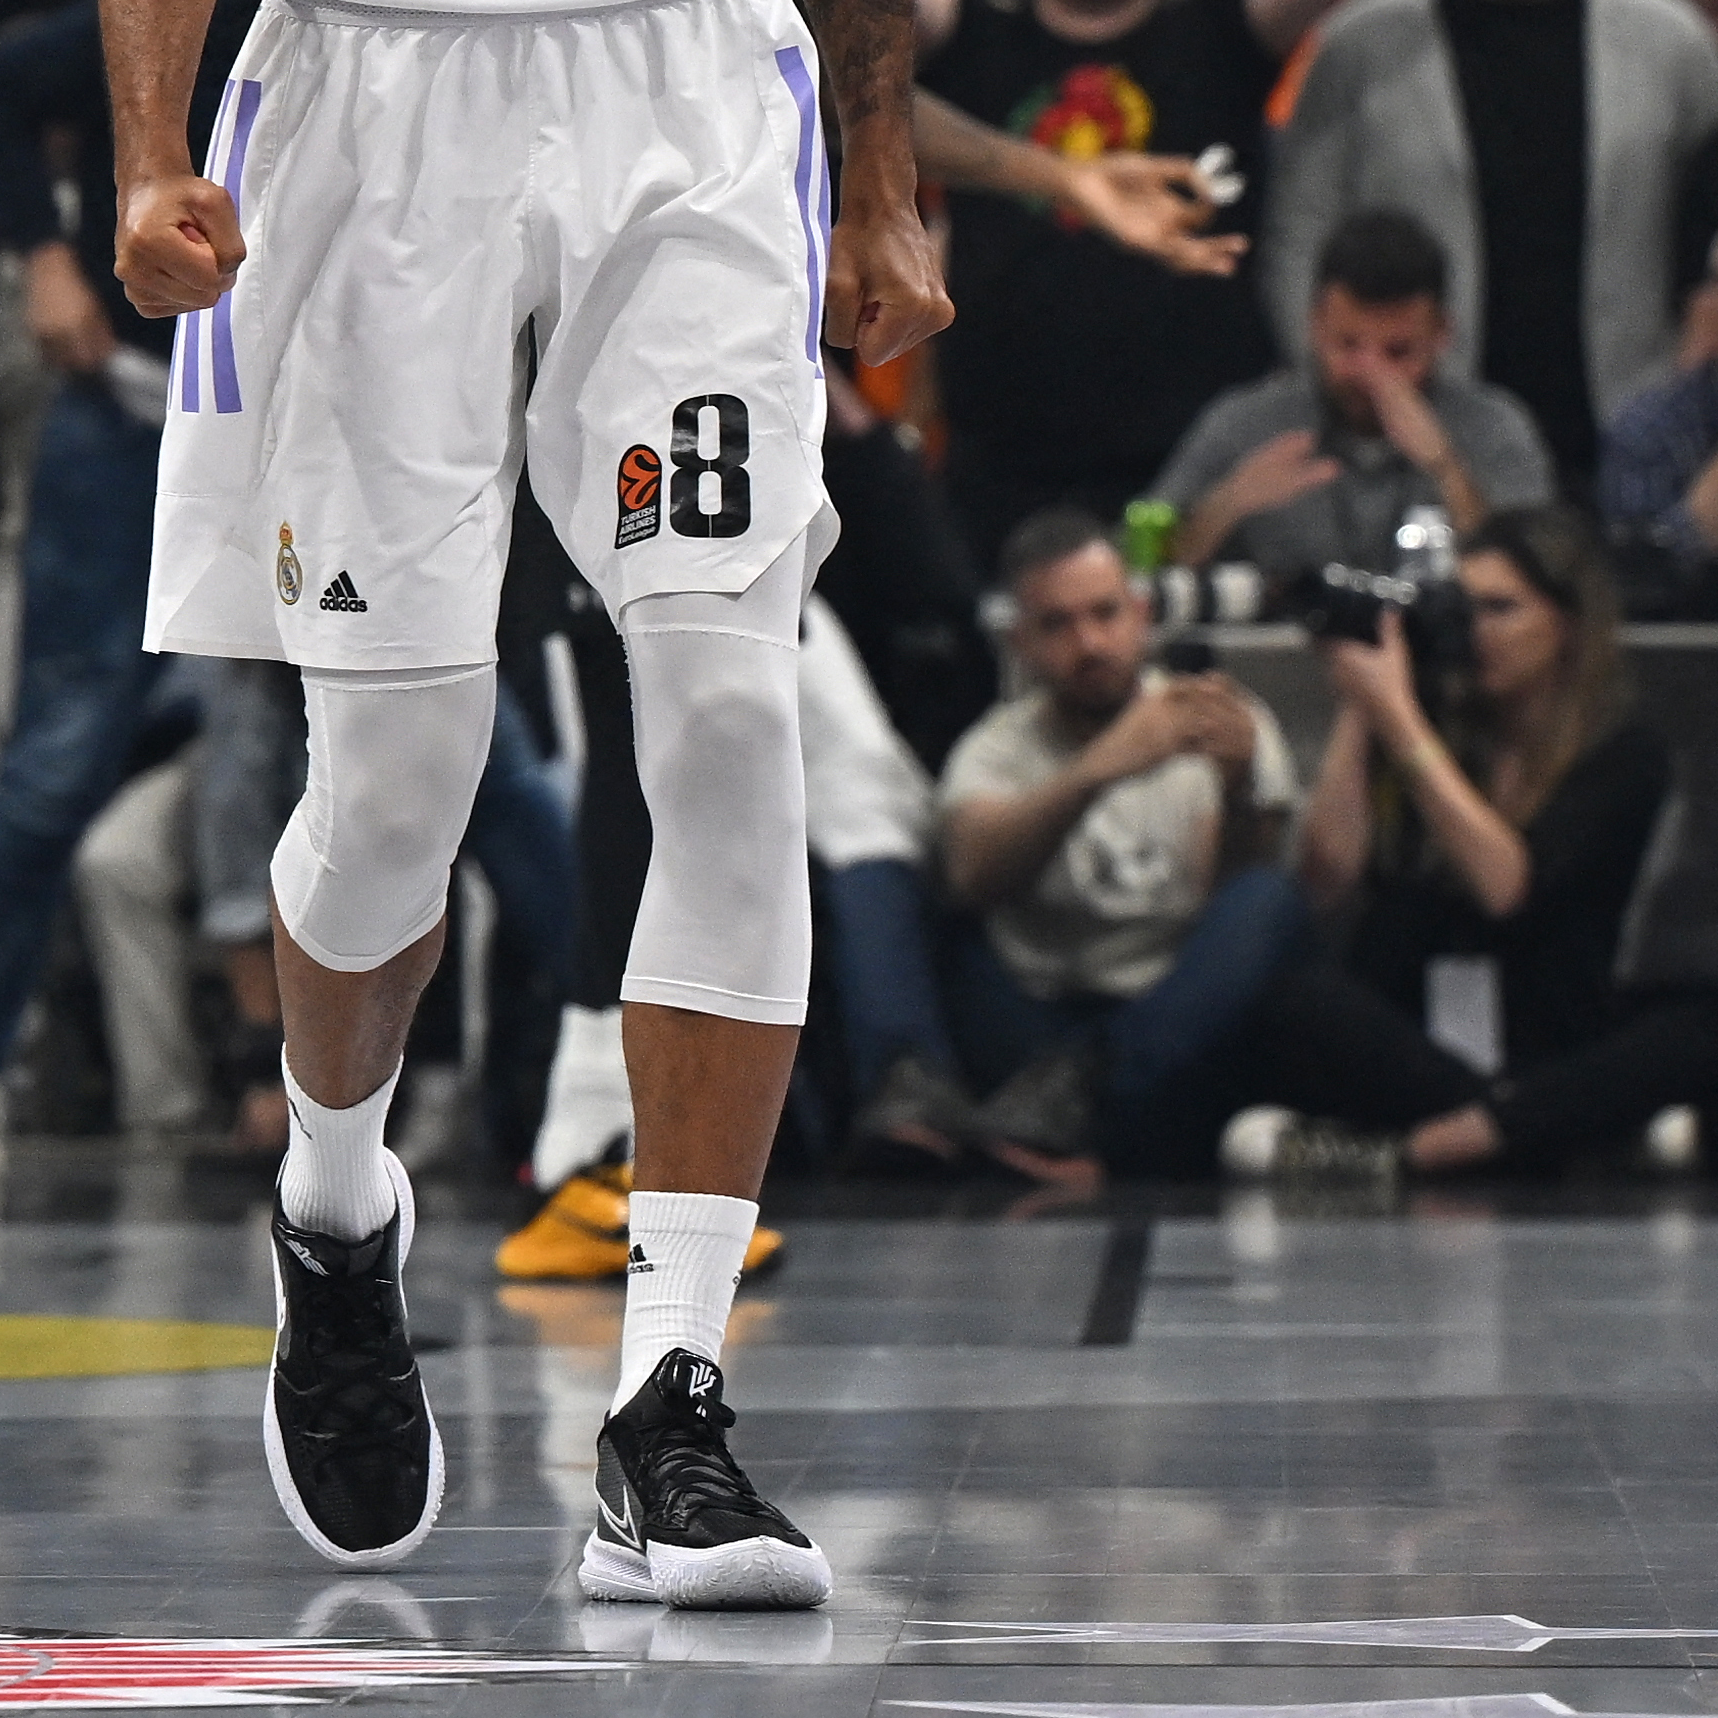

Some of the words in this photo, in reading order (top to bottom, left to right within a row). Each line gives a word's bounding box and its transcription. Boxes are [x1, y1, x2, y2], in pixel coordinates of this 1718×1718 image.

[670, 393, 752, 539] 8
[619, 515, 658, 536] AIRLINES
[620, 504, 658, 527] TURKISH
[319, 596, 369, 613] adidas
